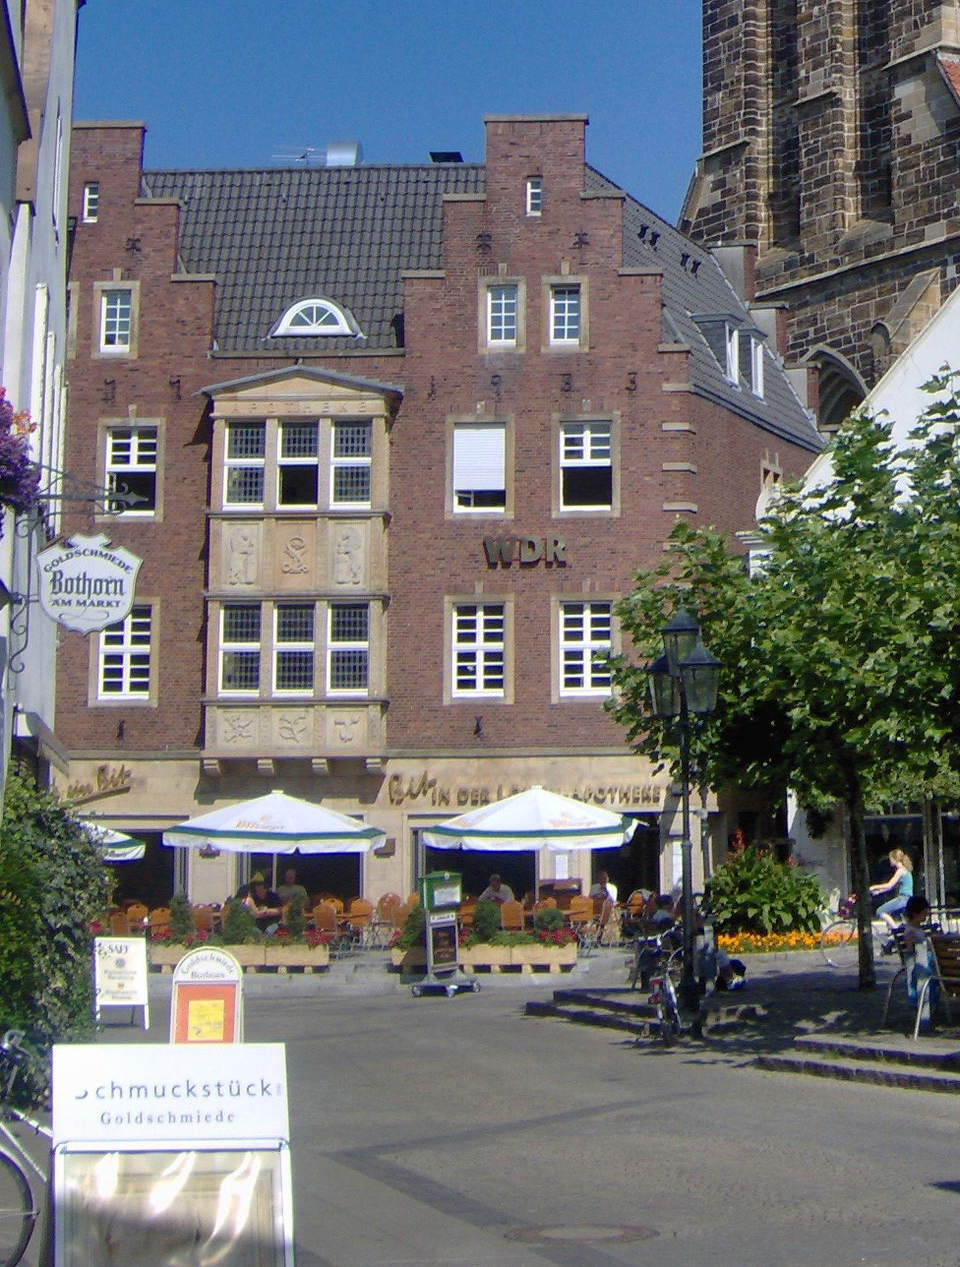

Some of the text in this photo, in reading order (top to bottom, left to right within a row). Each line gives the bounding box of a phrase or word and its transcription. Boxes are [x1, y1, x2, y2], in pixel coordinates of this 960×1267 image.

[43, 548, 133, 574] GOLDSCHMIEDE
[483, 533, 567, 569] WDR
[50, 569, 125, 599] Bothorn
[51, 599, 121, 608] AM MARKT
[387, 770, 437, 805] Bit
[431, 788, 450, 806] IN
[456, 787, 491, 806] DER
[101, 1109, 236, 1126] Goldschmiede
